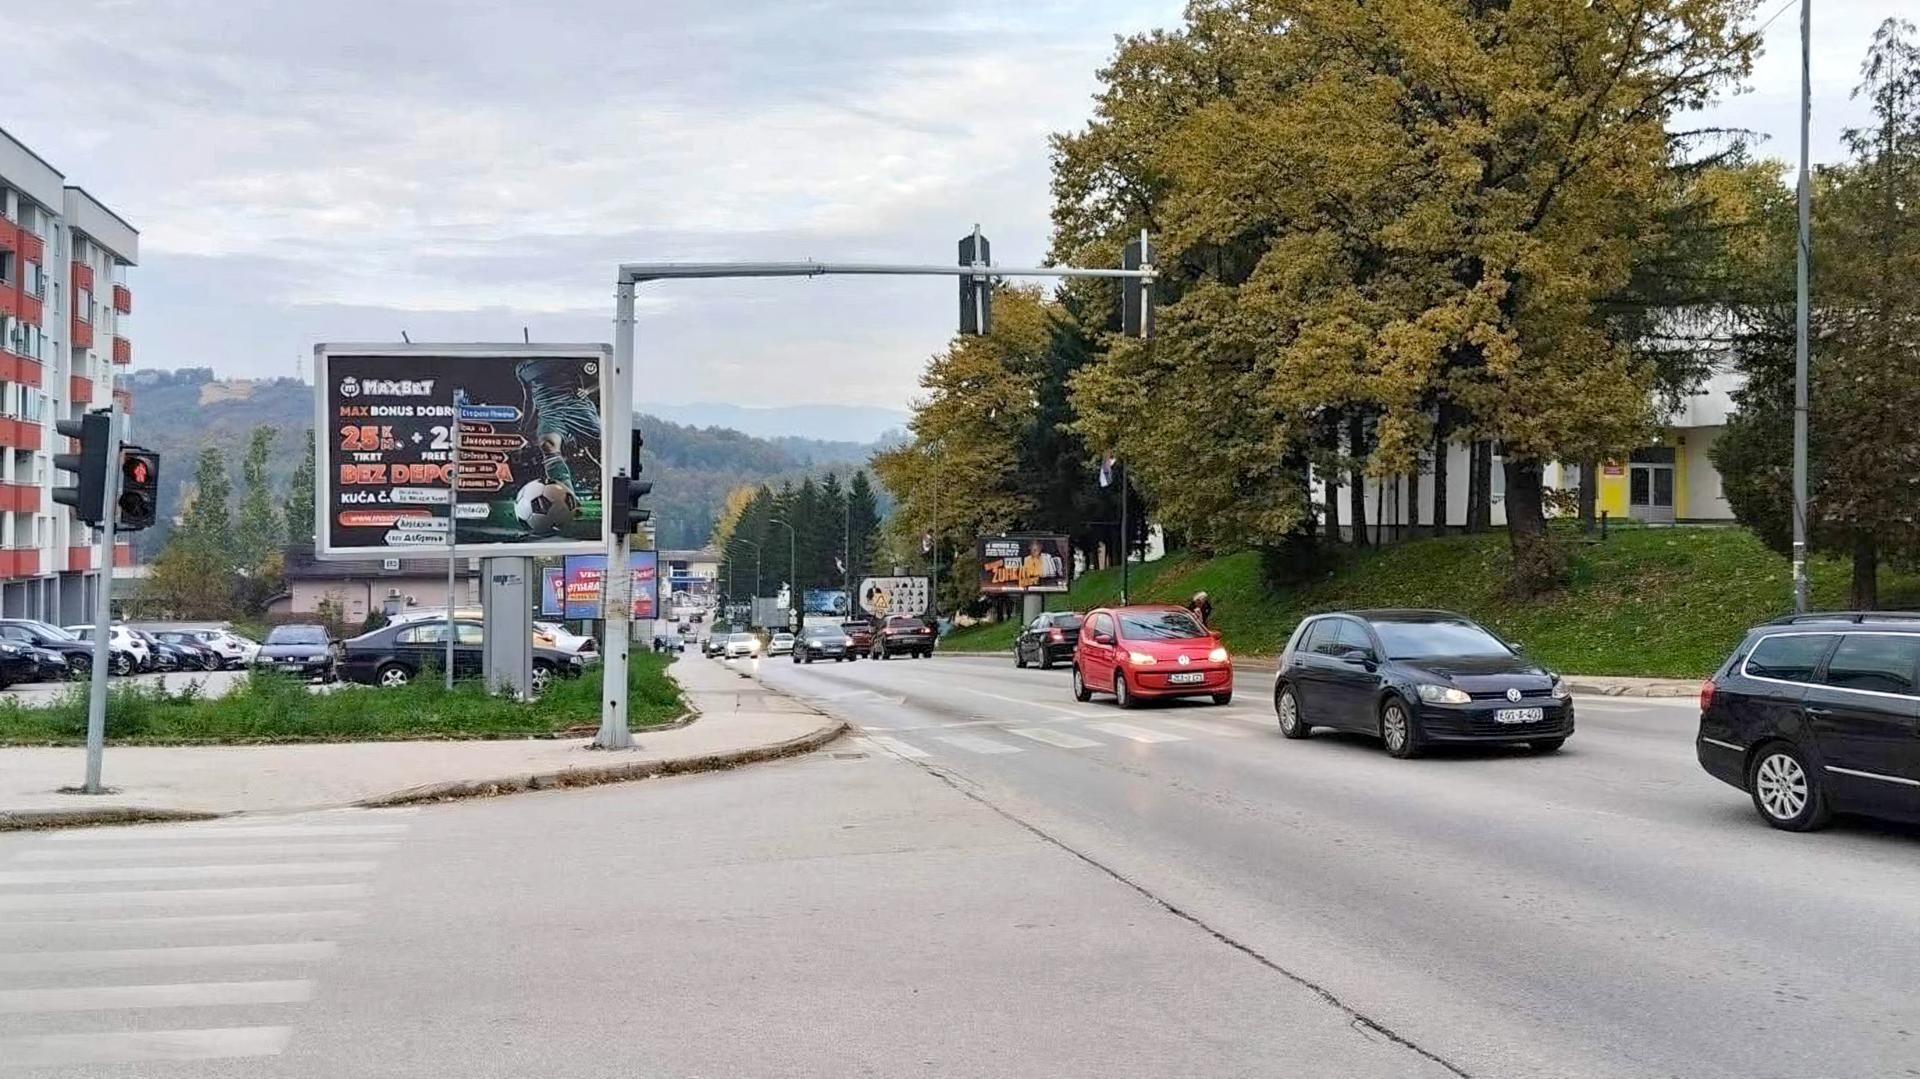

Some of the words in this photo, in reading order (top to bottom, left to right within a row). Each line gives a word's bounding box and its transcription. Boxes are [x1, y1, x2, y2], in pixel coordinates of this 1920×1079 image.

[340, 406, 368, 416] MAX
[371, 406, 414, 416] BONUS
[340, 425, 379, 450] 25
[421, 452, 447, 461] FREE
[341, 463, 386, 485] BEZ
[341, 491, 376, 503] KUĆA
